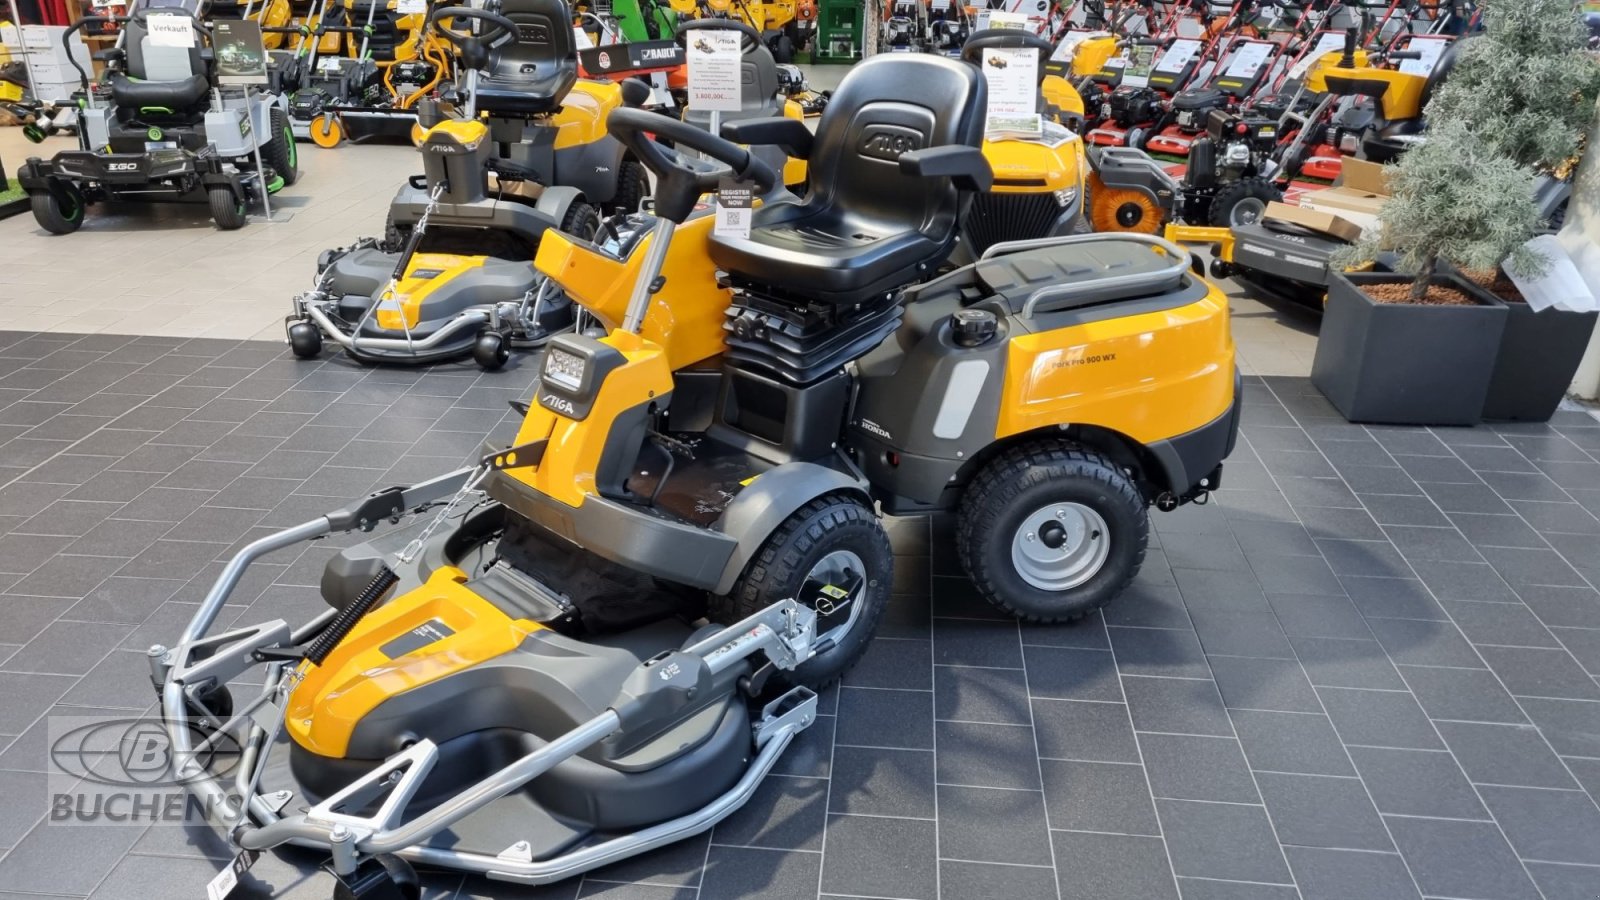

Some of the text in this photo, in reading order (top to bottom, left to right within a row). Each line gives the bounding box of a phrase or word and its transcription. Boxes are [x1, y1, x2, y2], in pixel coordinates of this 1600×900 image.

[152, 24, 188, 32] Verkauft
[651, 47, 676, 59] RAUCH
[108, 163, 137, 171] EGO
[1102, 353, 1117, 362] WX
[542, 394, 574, 414] STIGA
[861, 421, 891, 440] HONDA
